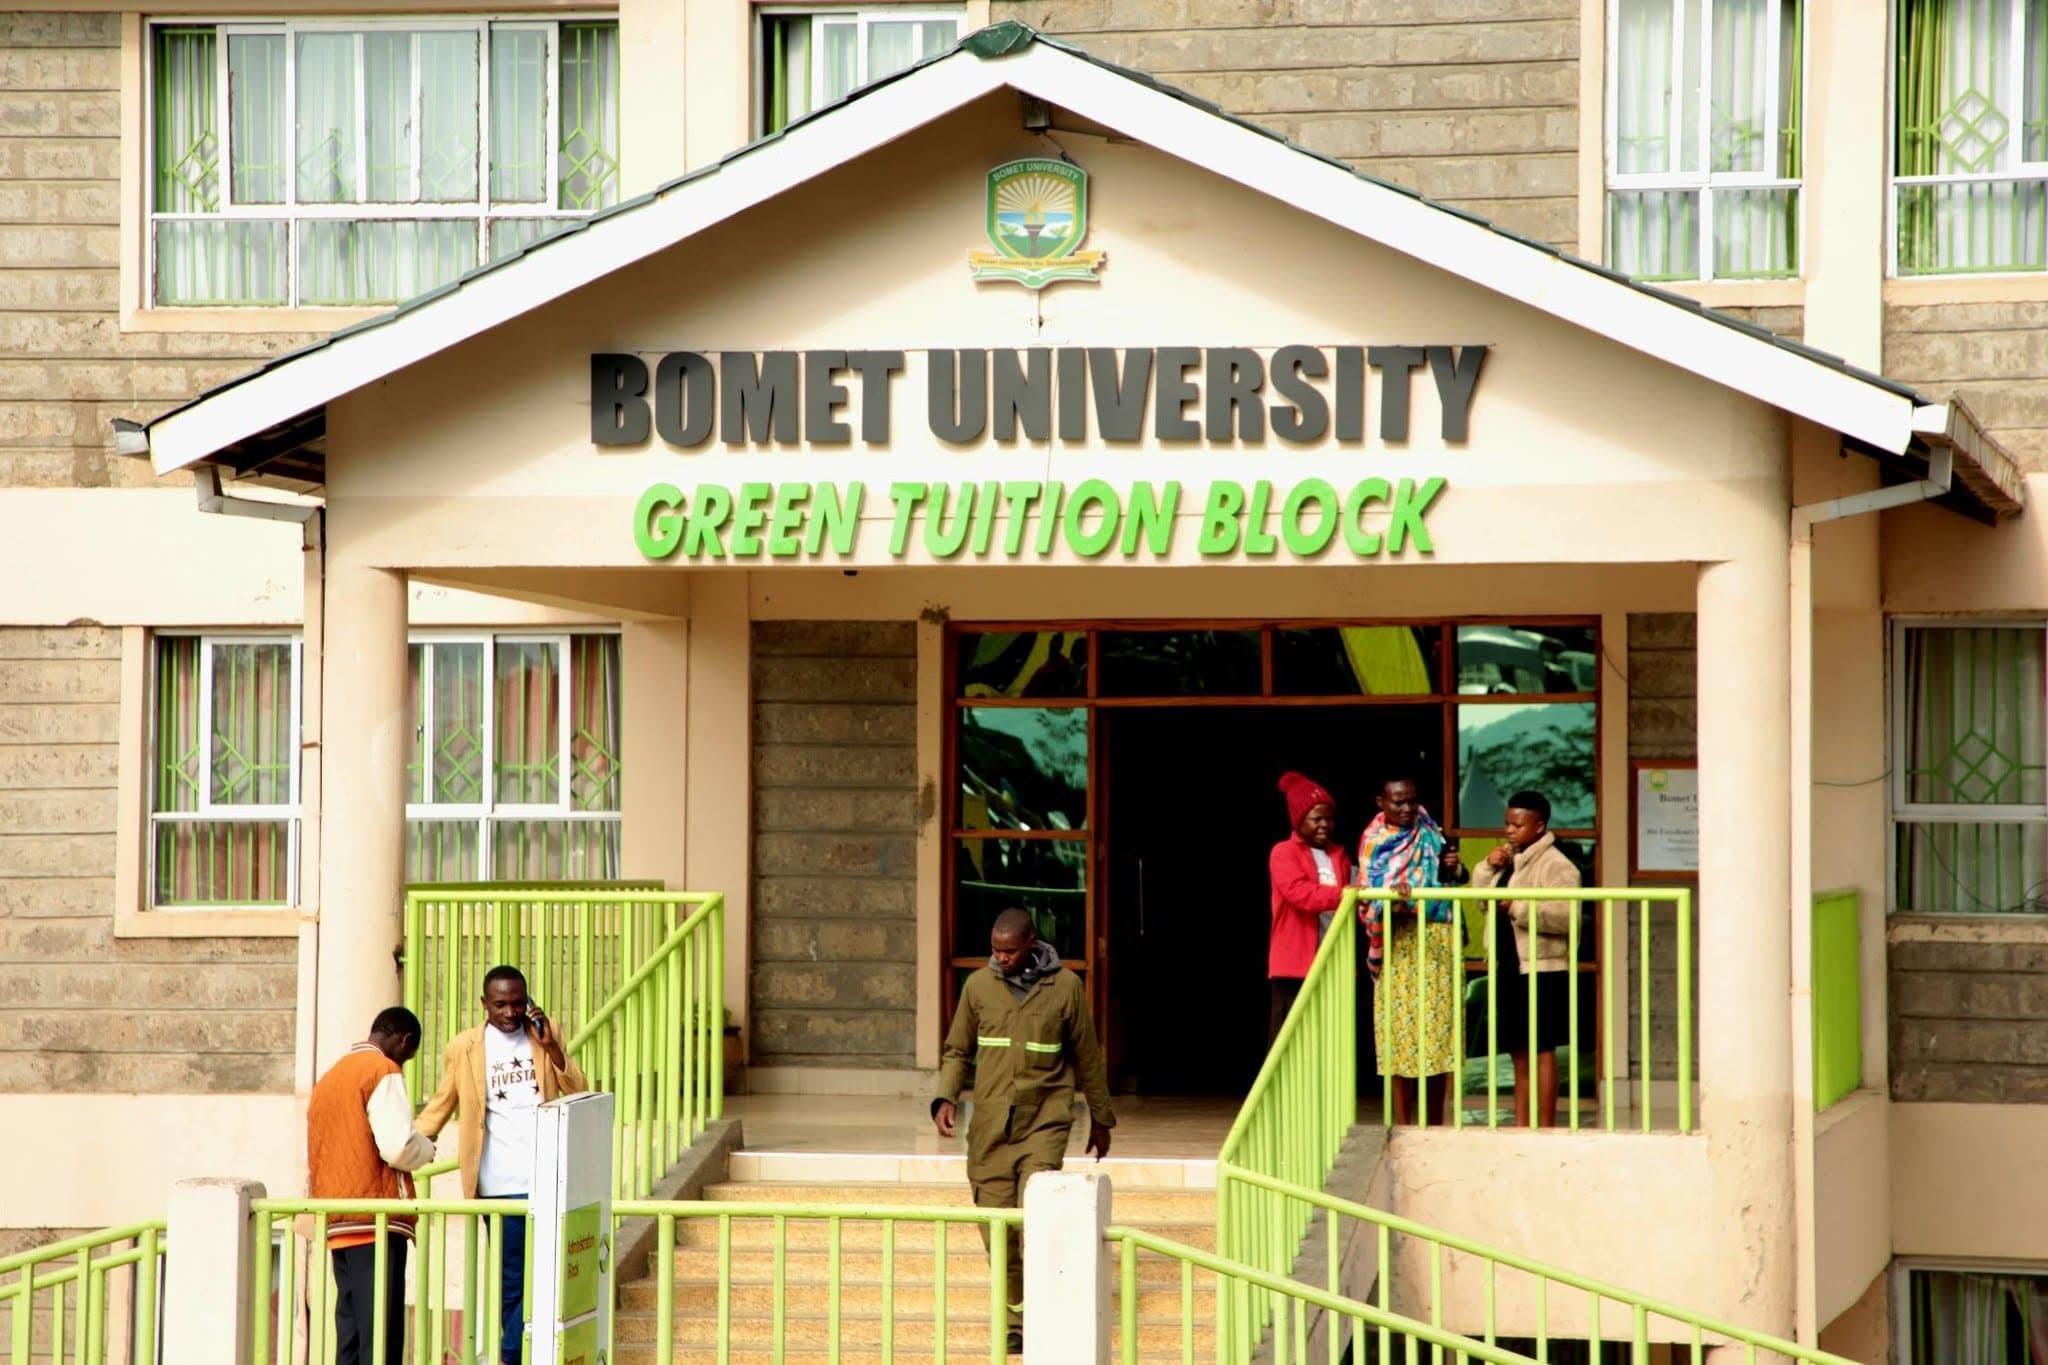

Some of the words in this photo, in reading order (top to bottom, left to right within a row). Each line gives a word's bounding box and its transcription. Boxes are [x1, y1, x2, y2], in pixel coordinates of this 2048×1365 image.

[992, 163, 1024, 182] BOMET
[1026, 162, 1080, 181] UNIVERSITY
[590, 349, 905, 446] BOMET
[927, 344, 1489, 444] UNIVERSITY
[633, 480, 865, 558] GREEN
[888, 478, 1182, 558] TUITION
[1196, 476, 1447, 556] BLOCK
